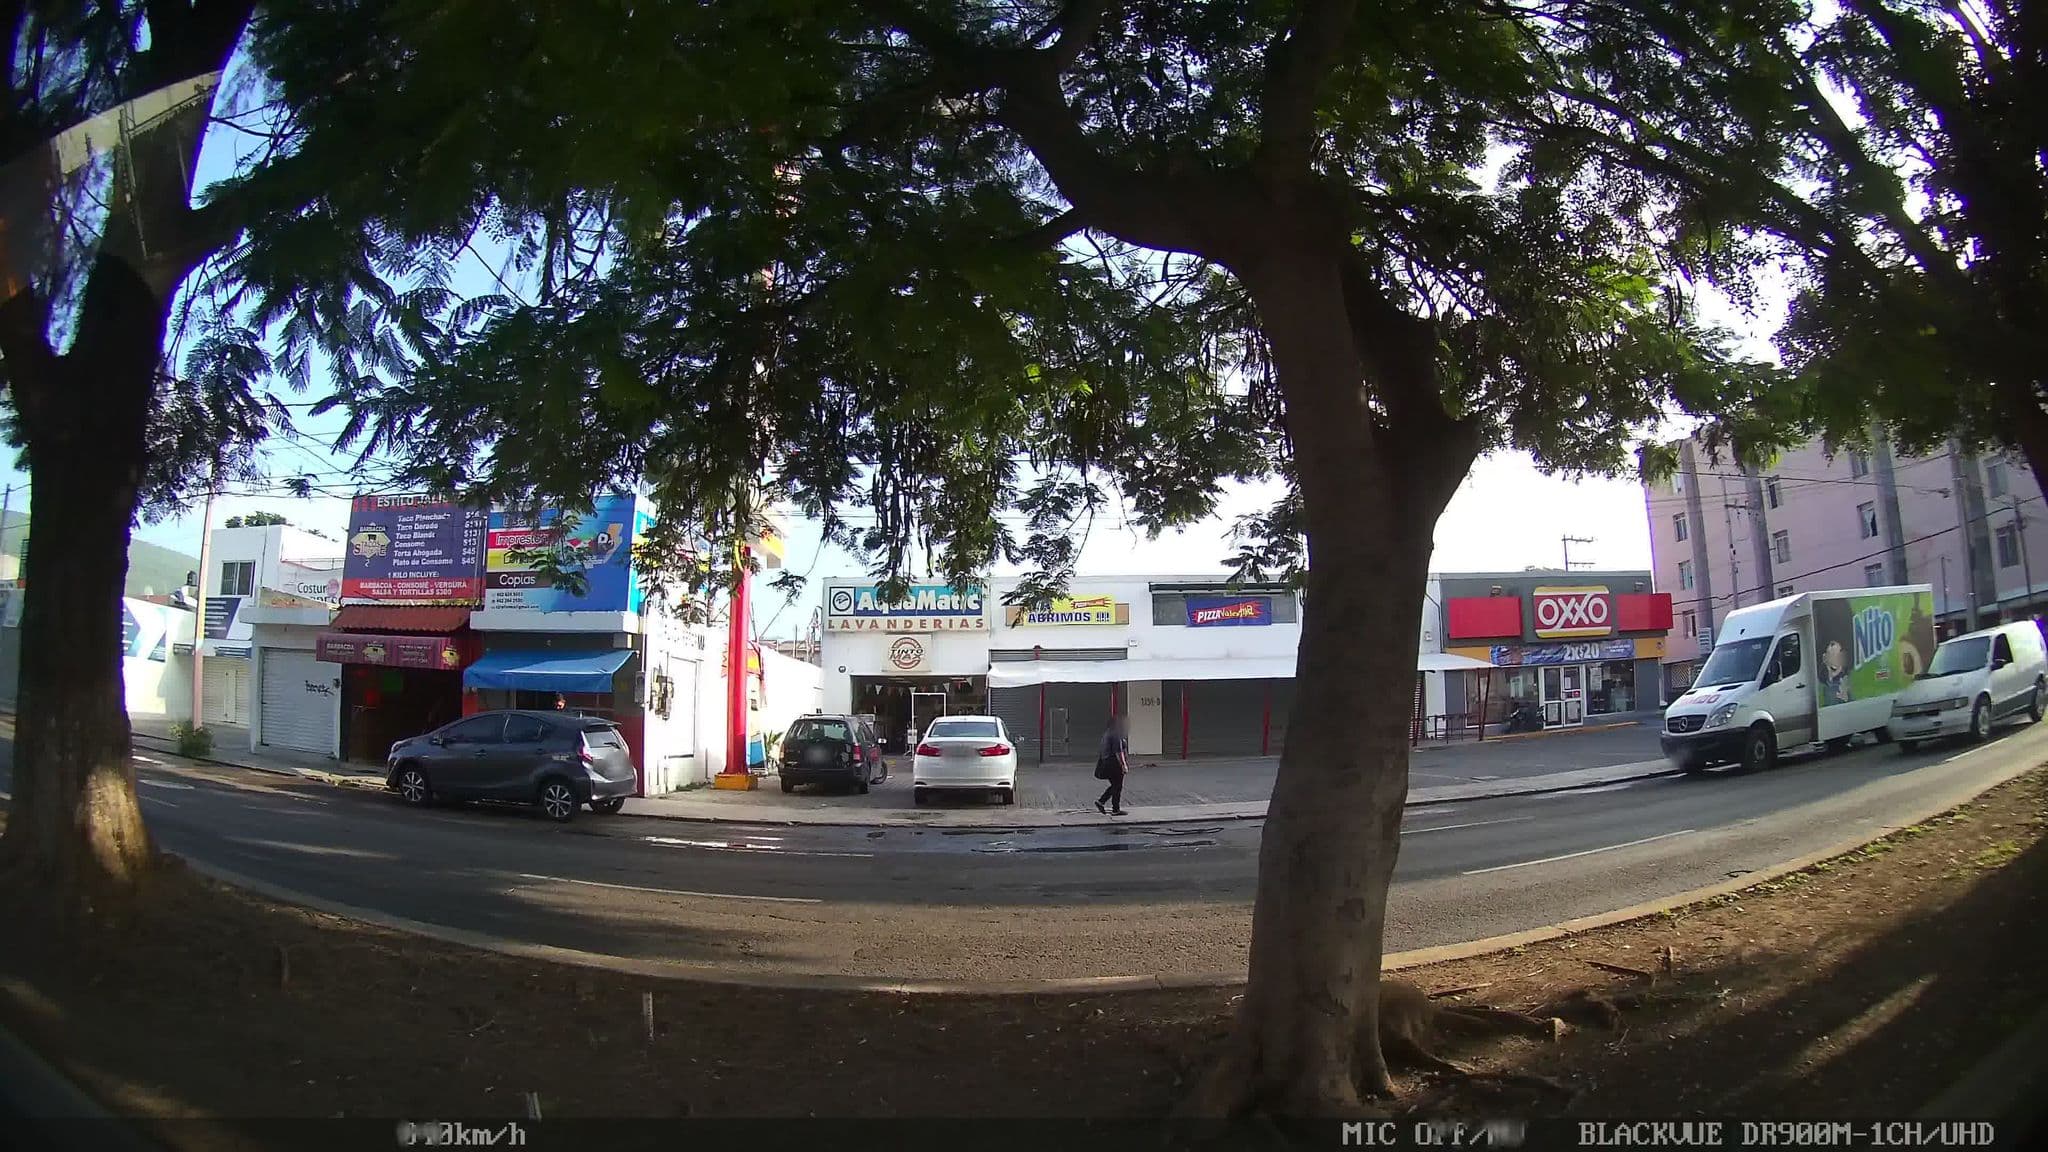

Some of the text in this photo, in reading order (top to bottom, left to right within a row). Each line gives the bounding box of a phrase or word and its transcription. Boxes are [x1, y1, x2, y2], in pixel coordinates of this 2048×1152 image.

[377, 496, 413, 507] ESTILO
[414, 522, 438, 530] Dorado
[412, 549, 443, 557] Ahogada
[392, 571, 408, 579] KILO
[500, 574, 536, 587] Copias
[1198, 609, 1221, 622] PIZZA
[1538, 592, 1608, 631] OXXO
[1028, 612, 1091, 623] ABRIMOS
[828, 619, 984, 630] LAVANDERIAS
[1853, 607, 1893, 669] Nito
